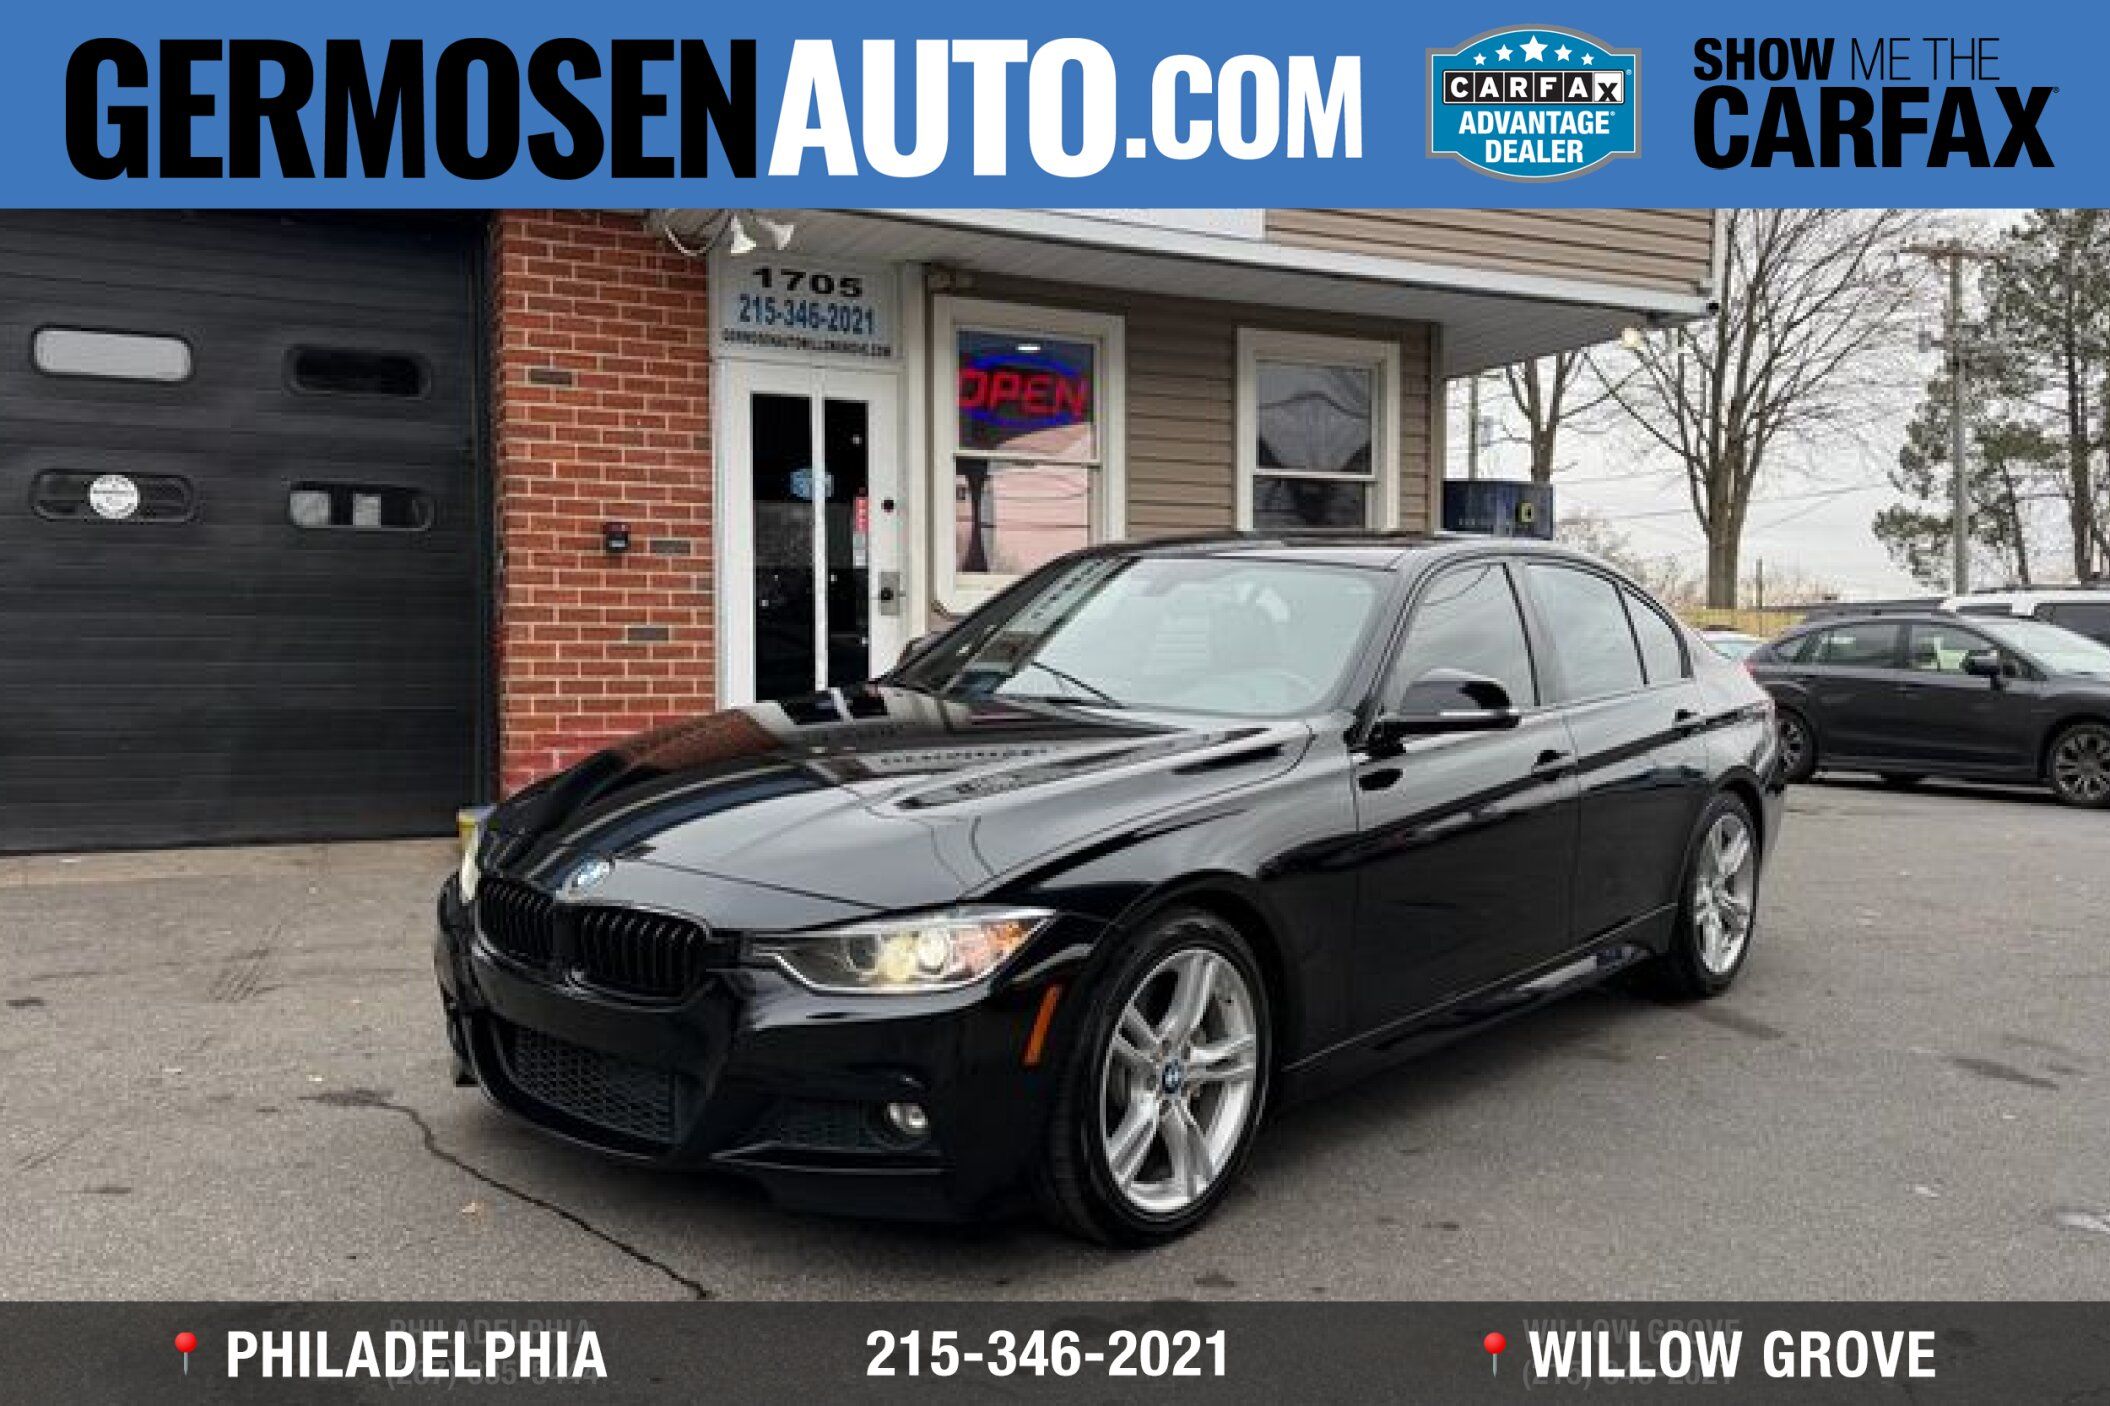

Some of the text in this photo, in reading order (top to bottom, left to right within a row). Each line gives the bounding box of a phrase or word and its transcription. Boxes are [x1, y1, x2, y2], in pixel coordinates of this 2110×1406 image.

[753, 265, 863, 298] 1705
[739, 293, 874, 335] 215-346-2021
[957, 368, 1089, 417] OPEN
